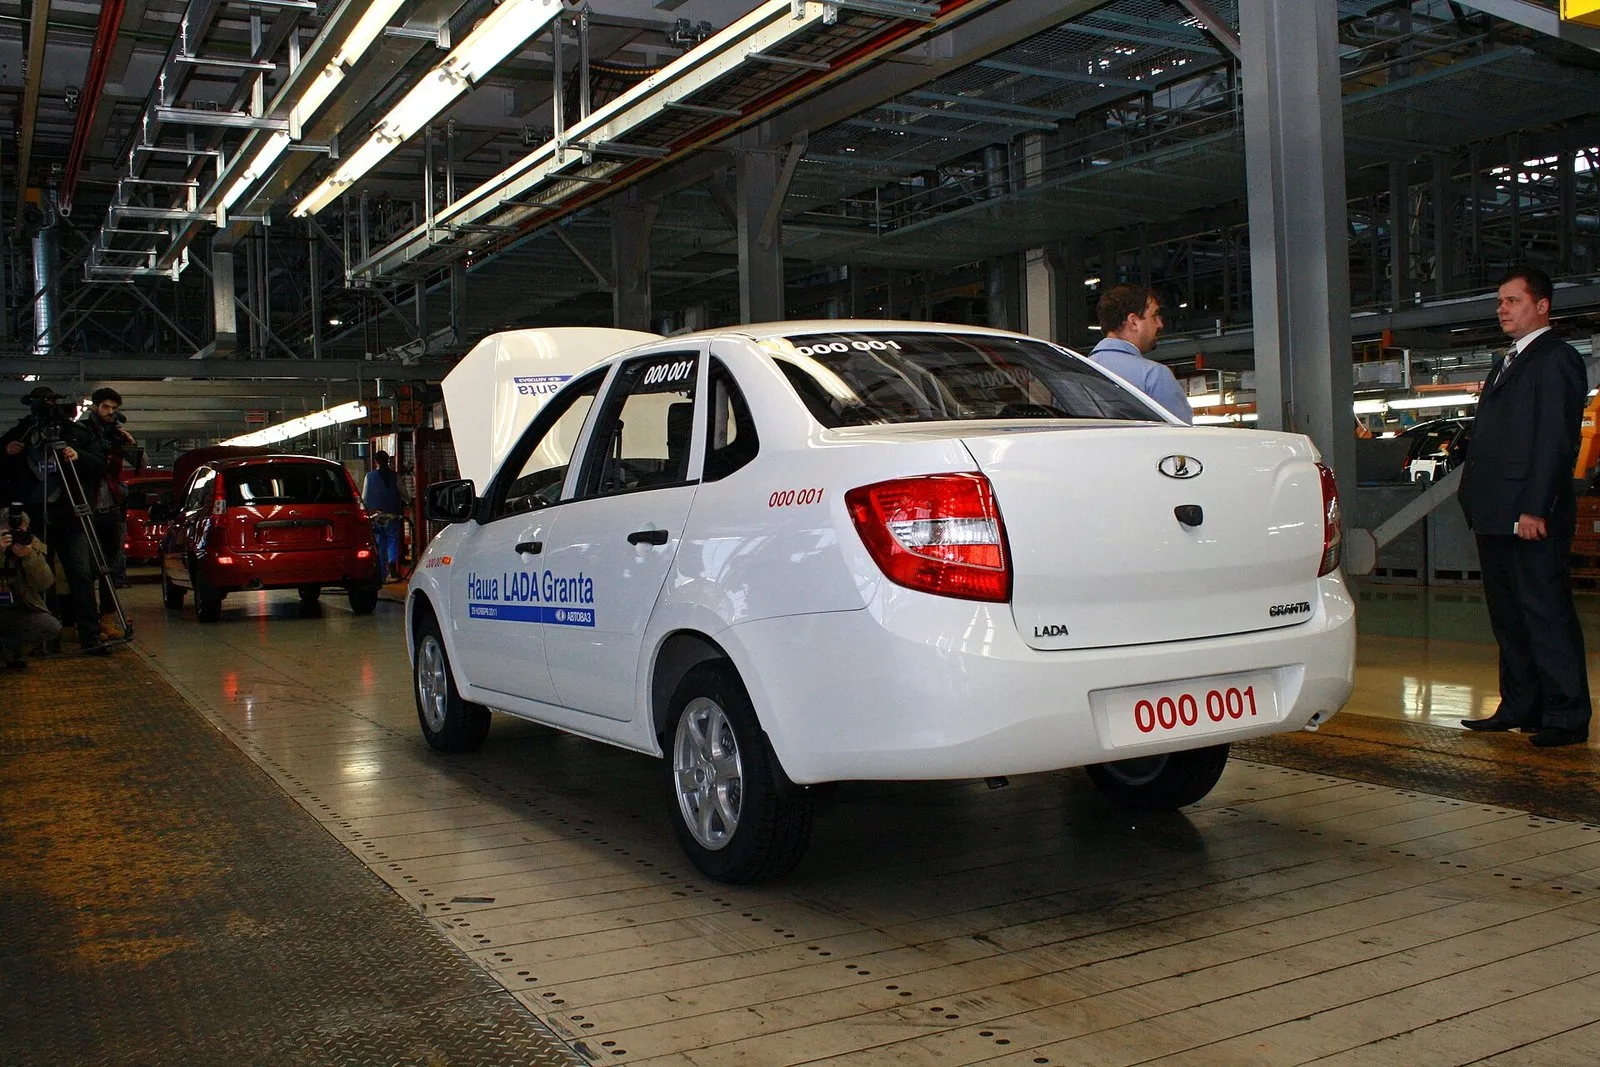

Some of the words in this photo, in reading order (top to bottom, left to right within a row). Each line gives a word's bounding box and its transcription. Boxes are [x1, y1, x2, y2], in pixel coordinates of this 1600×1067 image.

[796, 342, 849, 357] 000
[851, 340, 902, 351] 001
[644, 364, 669, 385] 000
[667, 360, 694, 382] 001
[517, 383, 558, 397] anta
[769, 489, 795, 507] 000
[797, 487, 824, 505] 001
[468, 572, 499, 601] Наша
[503, 571, 540, 602] LADA
[542, 570, 594, 603] Granta
[566, 611, 592, 623] АВТОВАЗ
[1269, 601, 1311, 617] GRANTA
[1034, 624, 1069, 638] LADA
[1134, 693, 1199, 733] 000
[1206, 685, 1257, 723] 001
